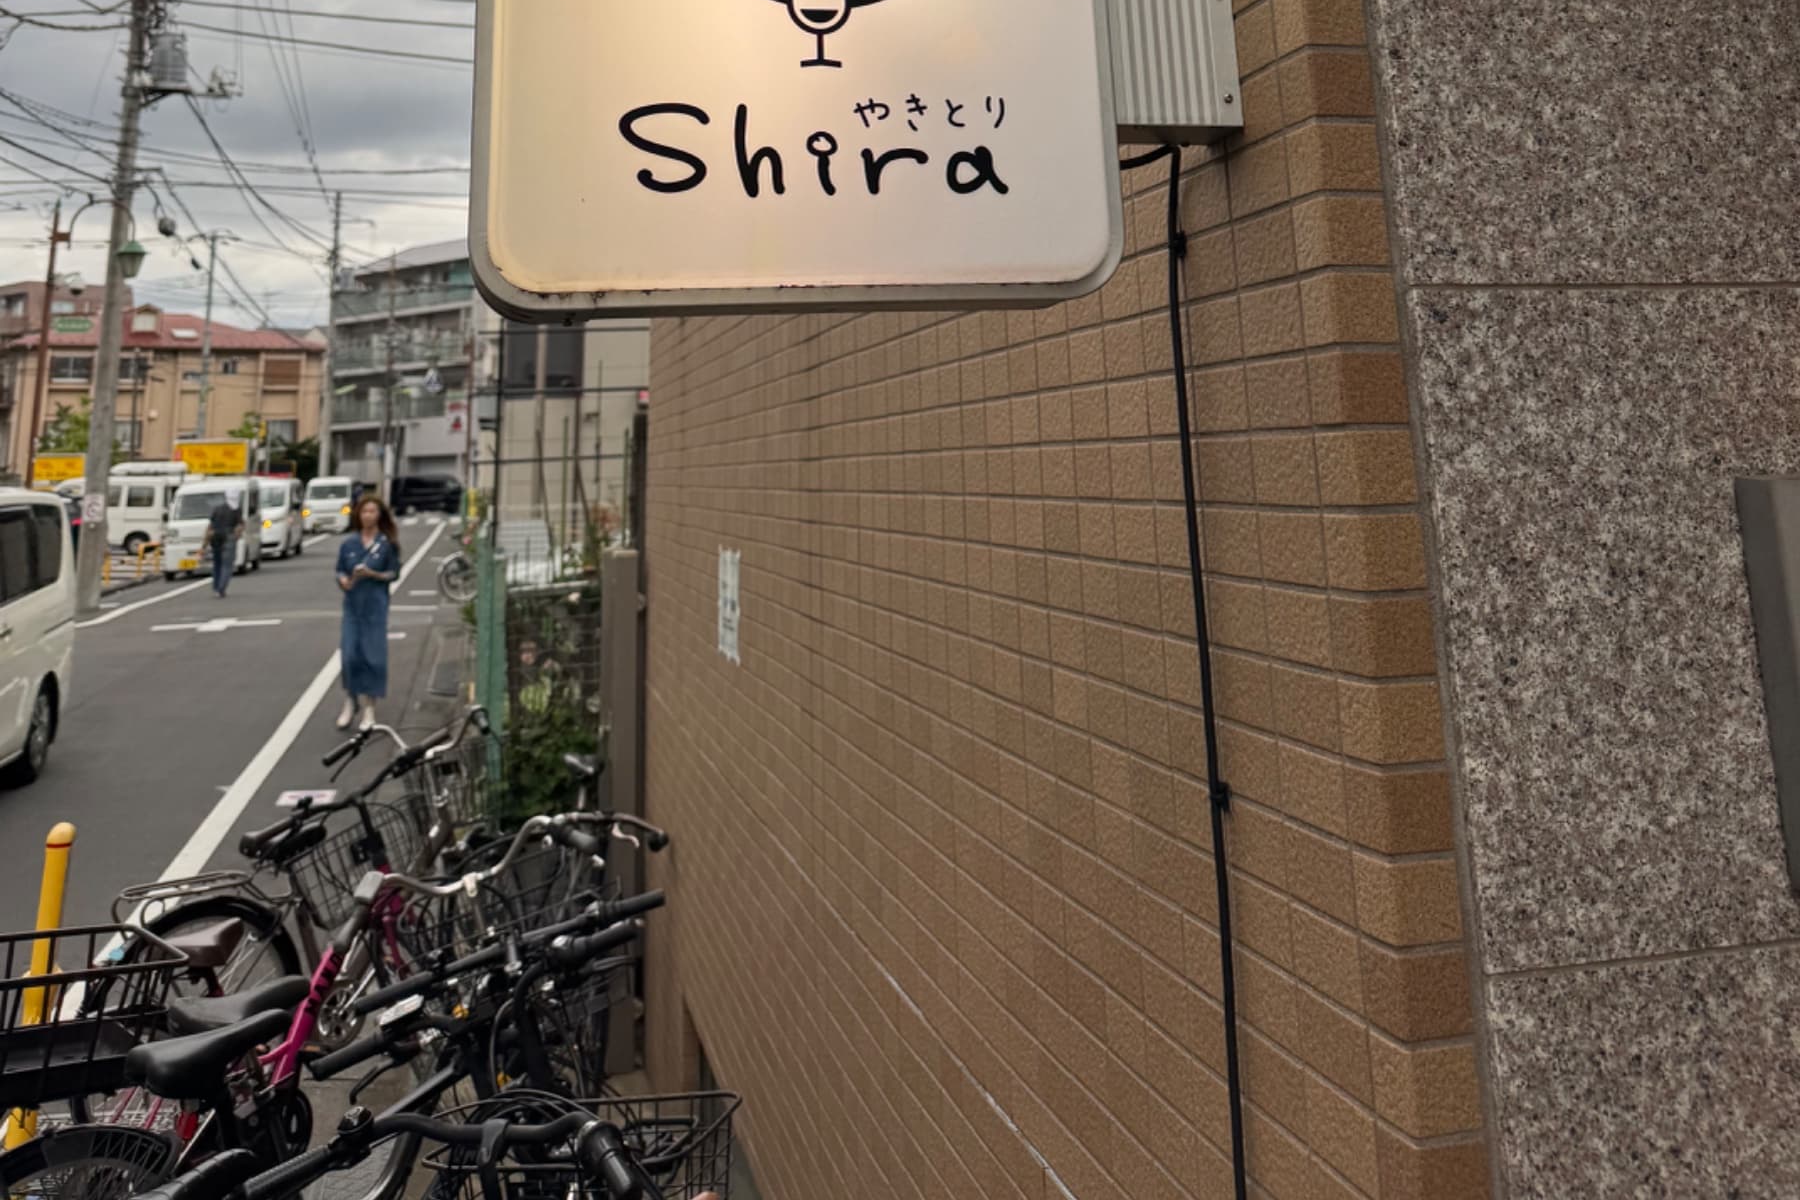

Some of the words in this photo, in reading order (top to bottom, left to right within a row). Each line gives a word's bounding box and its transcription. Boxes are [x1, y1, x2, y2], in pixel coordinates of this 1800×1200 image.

[853, 93, 1005, 132] やきとり
[618, 102, 1009, 198] Shira
